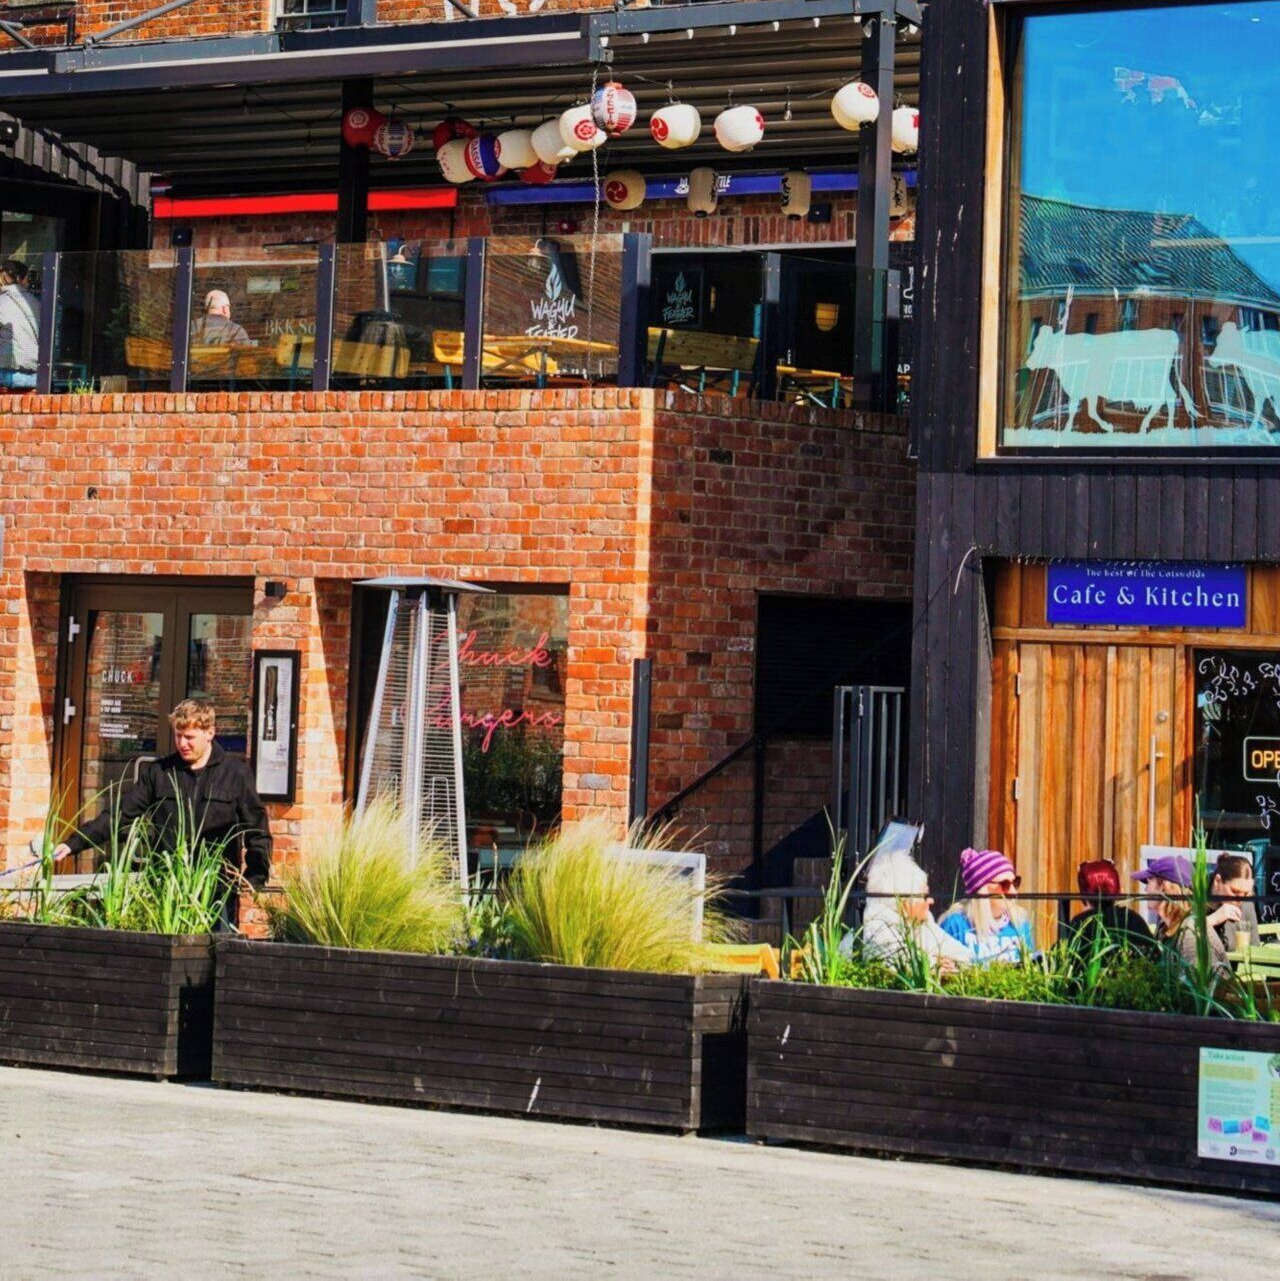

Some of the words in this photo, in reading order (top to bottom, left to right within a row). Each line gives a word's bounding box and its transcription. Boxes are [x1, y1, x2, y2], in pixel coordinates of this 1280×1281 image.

[531, 294, 576, 323] WAGYU
[265, 319, 295, 335] BKK
[1053, 584, 1106, 604] Cafe
[1117, 586, 1135, 605] &
[1146, 585, 1240, 607] Kitchen
[102, 670, 133, 683] CHUCK
